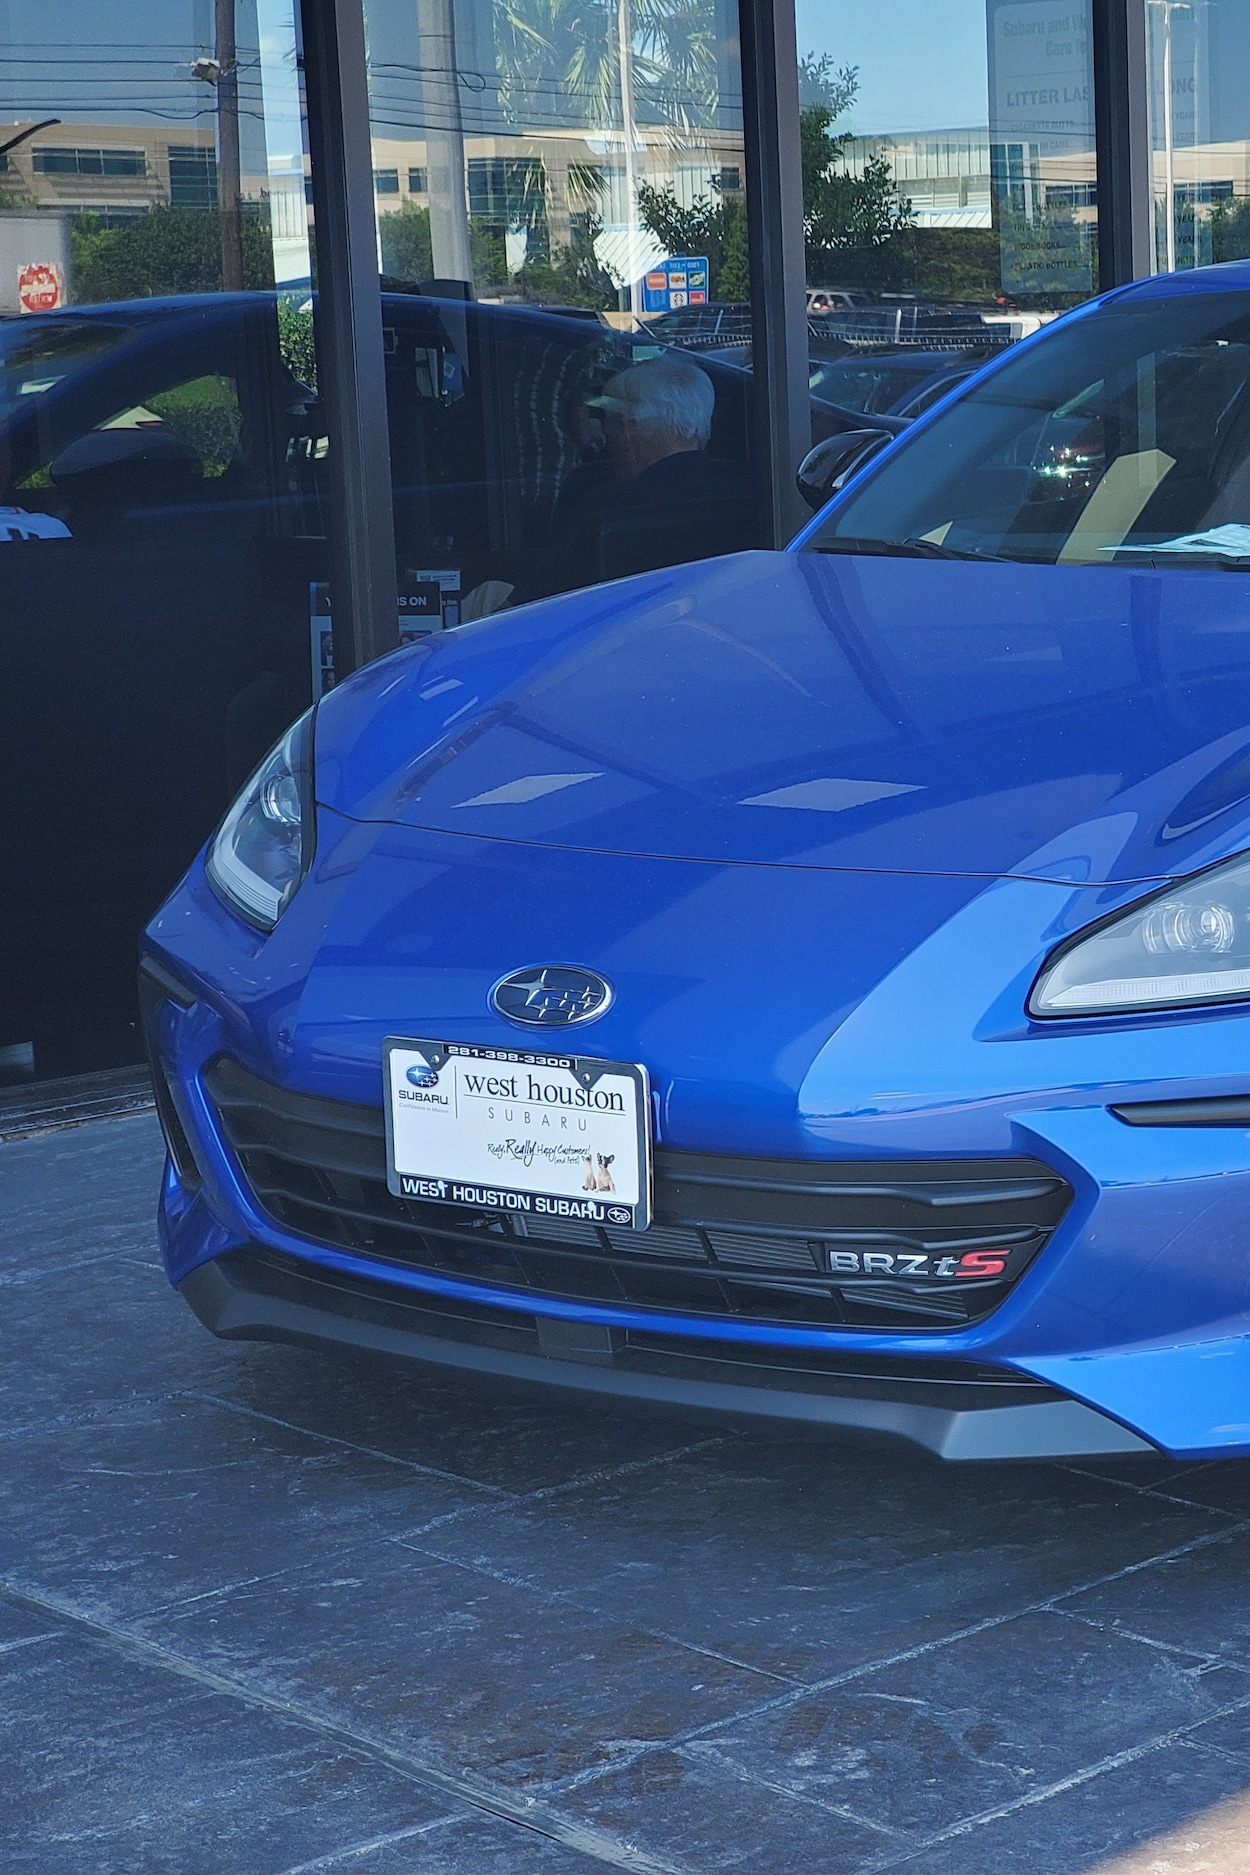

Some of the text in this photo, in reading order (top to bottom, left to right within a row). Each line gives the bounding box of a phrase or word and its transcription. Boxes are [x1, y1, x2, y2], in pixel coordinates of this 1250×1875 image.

[1003, 20, 1044, 38] Subaru
[1047, 15, 1069, 34] and
[1006, 88, 1059, 108] LITTER
[409, 596, 427, 606] ON
[448, 1045, 571, 1069] 281-398-3300
[398, 1089, 449, 1105] SUBARU
[464, 1073, 626, 1112] west houston
[488, 1106, 587, 1131] SUBARU
[505, 1138, 538, 1167] Really
[537, 1144, 557, 1163] Happy
[402, 1177, 605, 1221] WEST HOUSTON SUBARU
[829, 1249, 1011, 1277] BRZ tS
